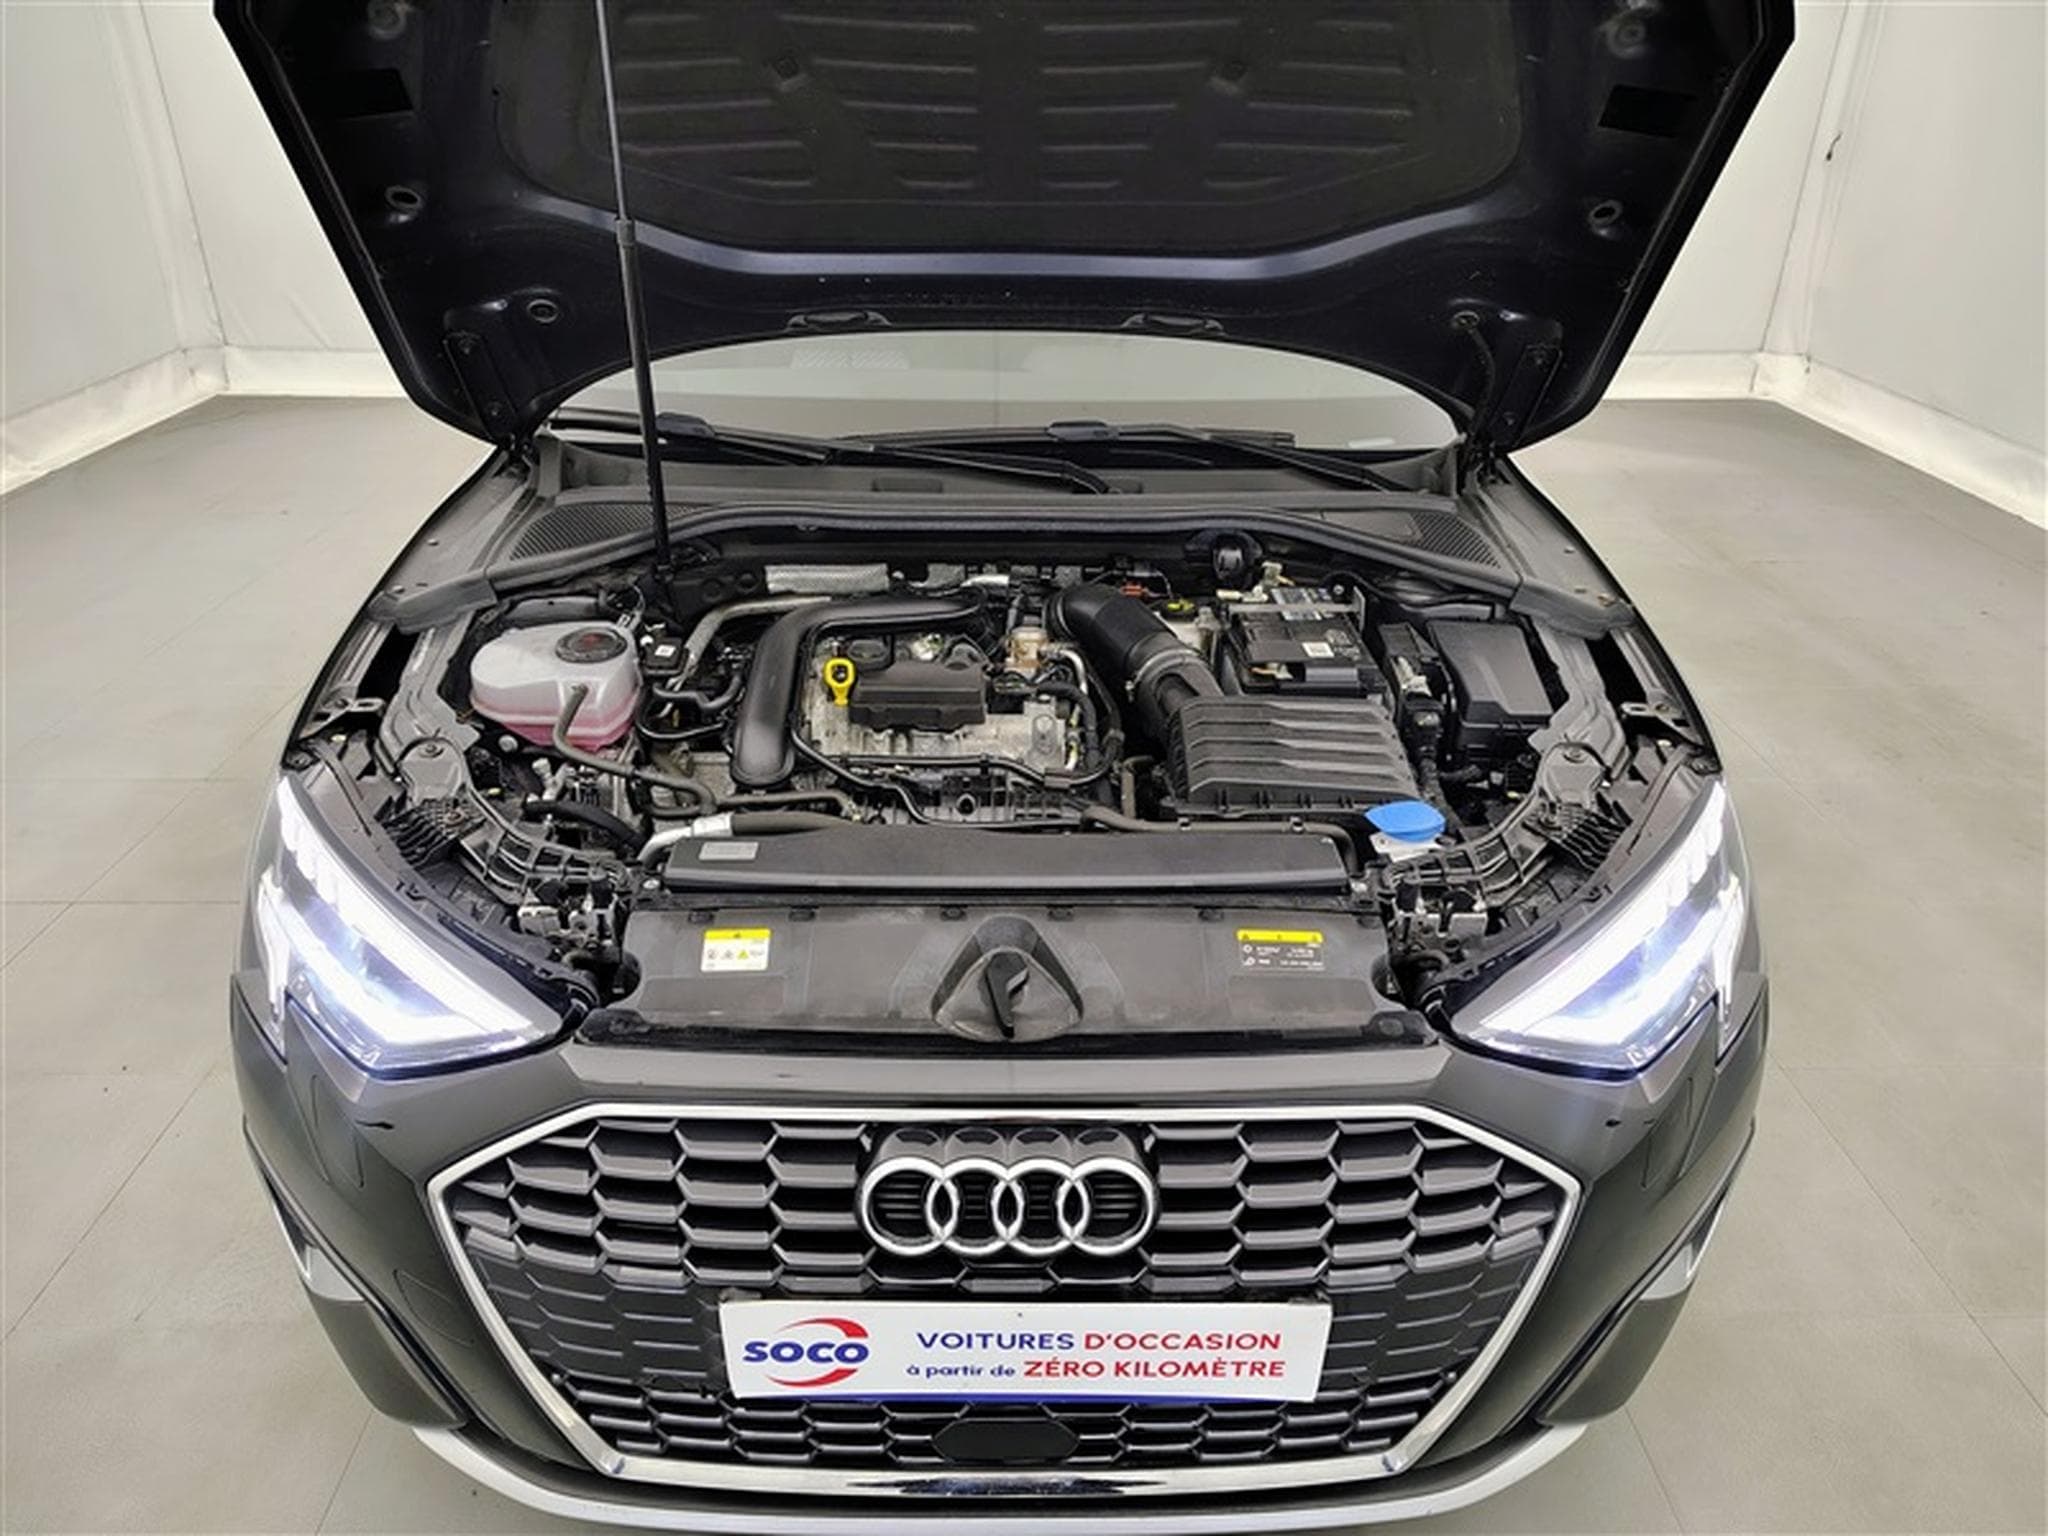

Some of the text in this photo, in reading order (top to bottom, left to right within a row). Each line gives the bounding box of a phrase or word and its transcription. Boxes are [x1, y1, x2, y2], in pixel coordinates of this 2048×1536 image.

[743, 1341, 869, 1364] SOCO
[917, 1332, 1282, 1351] VOITURES D'OCCASION
[907, 1357, 1286, 1379] à partir de ZÉRO KILOMÈTRE
